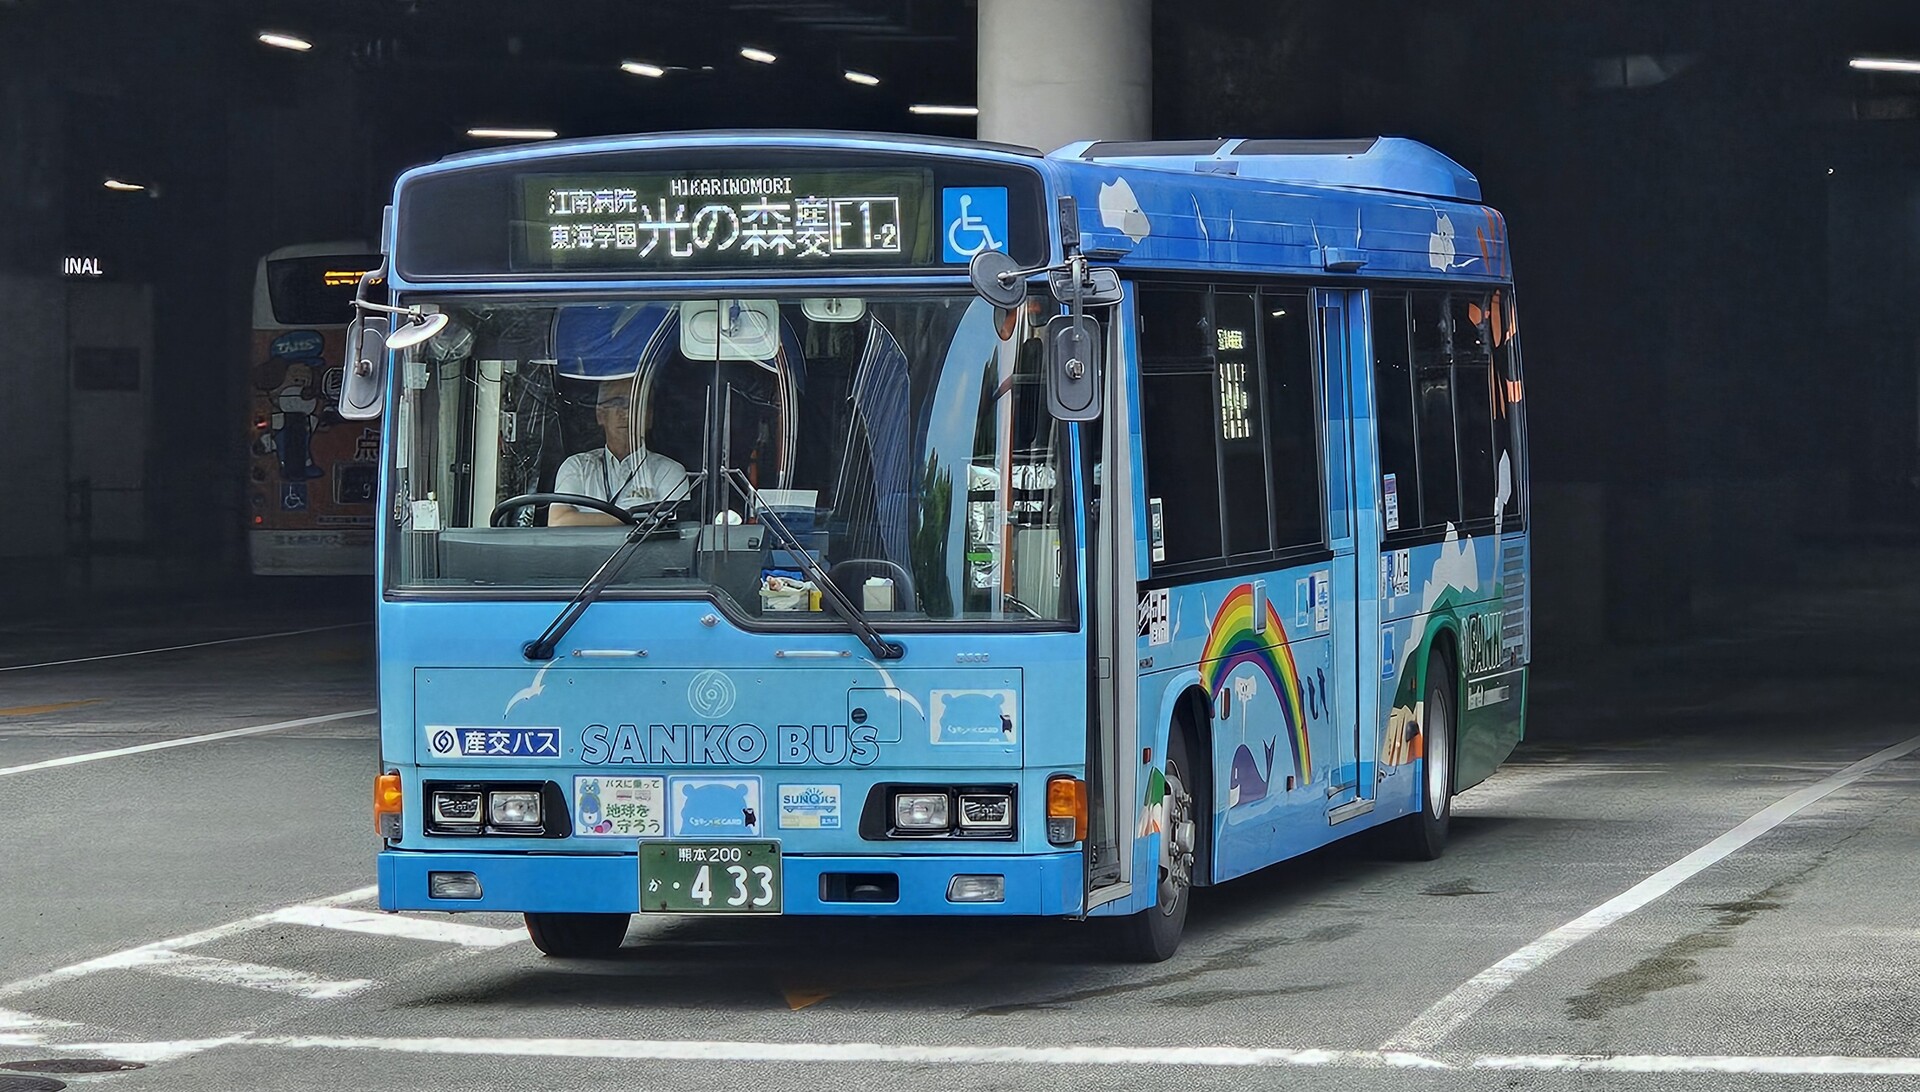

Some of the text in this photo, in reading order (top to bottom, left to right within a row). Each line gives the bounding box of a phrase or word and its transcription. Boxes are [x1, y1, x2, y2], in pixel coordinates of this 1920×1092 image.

[671, 178, 792, 195] HIKARINOMORI
[549, 188, 638, 215] 江南病院
[550, 224, 638, 249] 東海学園
[639, 197, 797, 257] 光の森
[64, 257, 103, 275] INAL
[463, 730, 558, 755] 産交バス
[580, 723, 880, 766] SANKO BUS
[606, 803, 650, 818] 地球を
[617, 819, 660, 834] 守ろう
[648, 879, 662, 893] か
